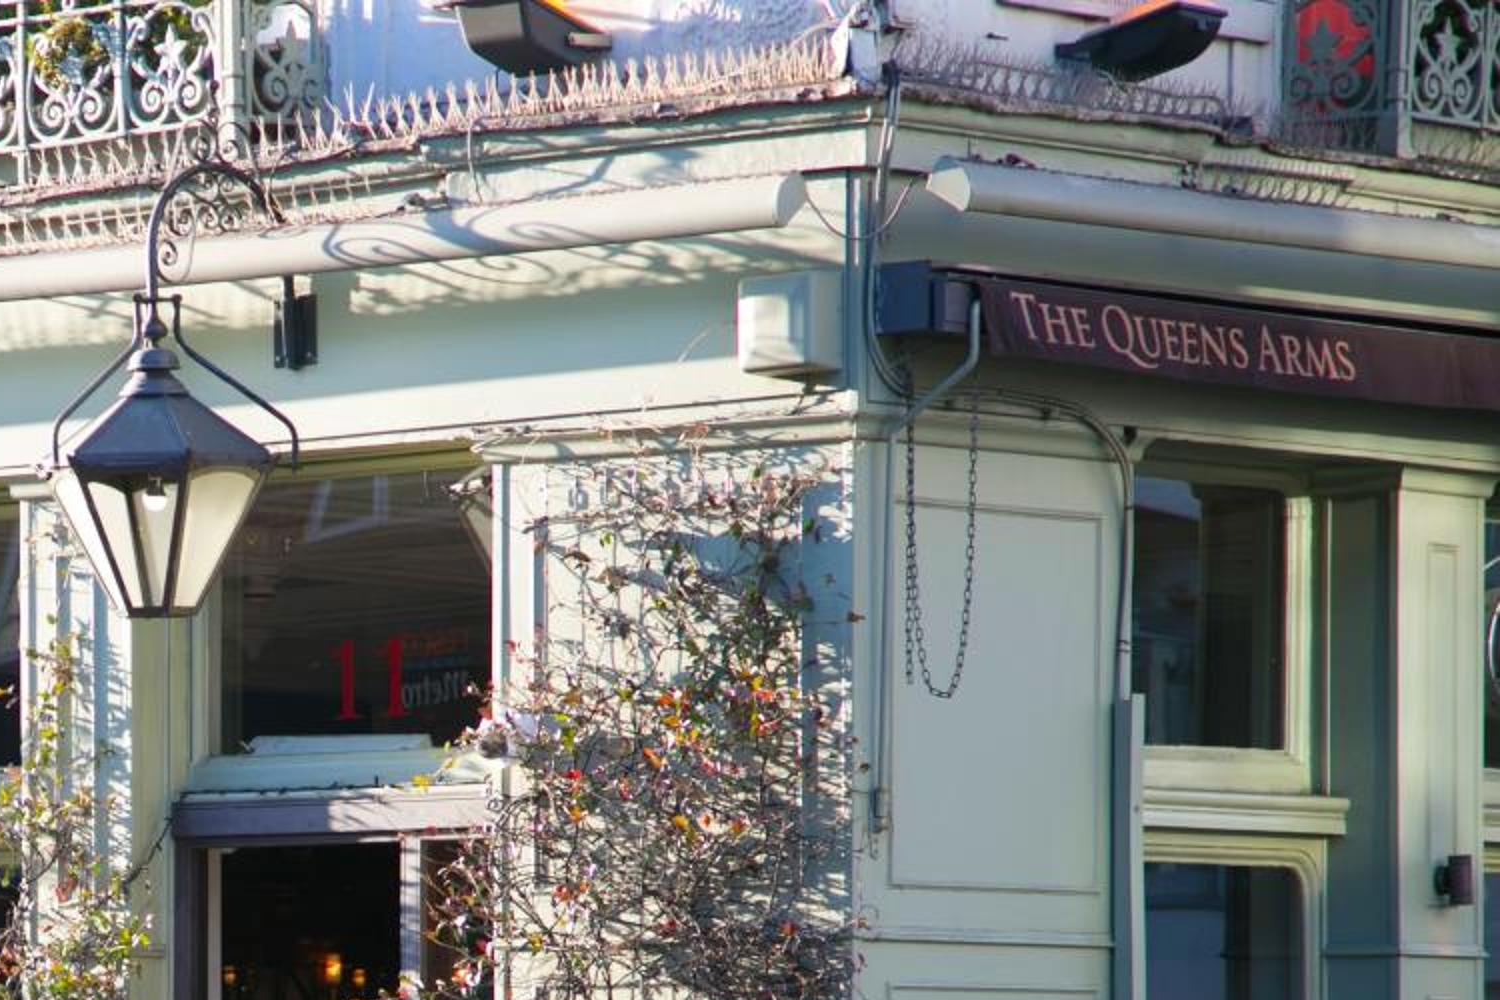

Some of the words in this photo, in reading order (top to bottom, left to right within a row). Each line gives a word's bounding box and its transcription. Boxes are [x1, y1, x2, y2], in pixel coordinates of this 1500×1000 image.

[1009, 291, 1096, 350] THE
[1101, 305, 1249, 369] QUEENS
[1259, 325, 1357, 382] ARMS
